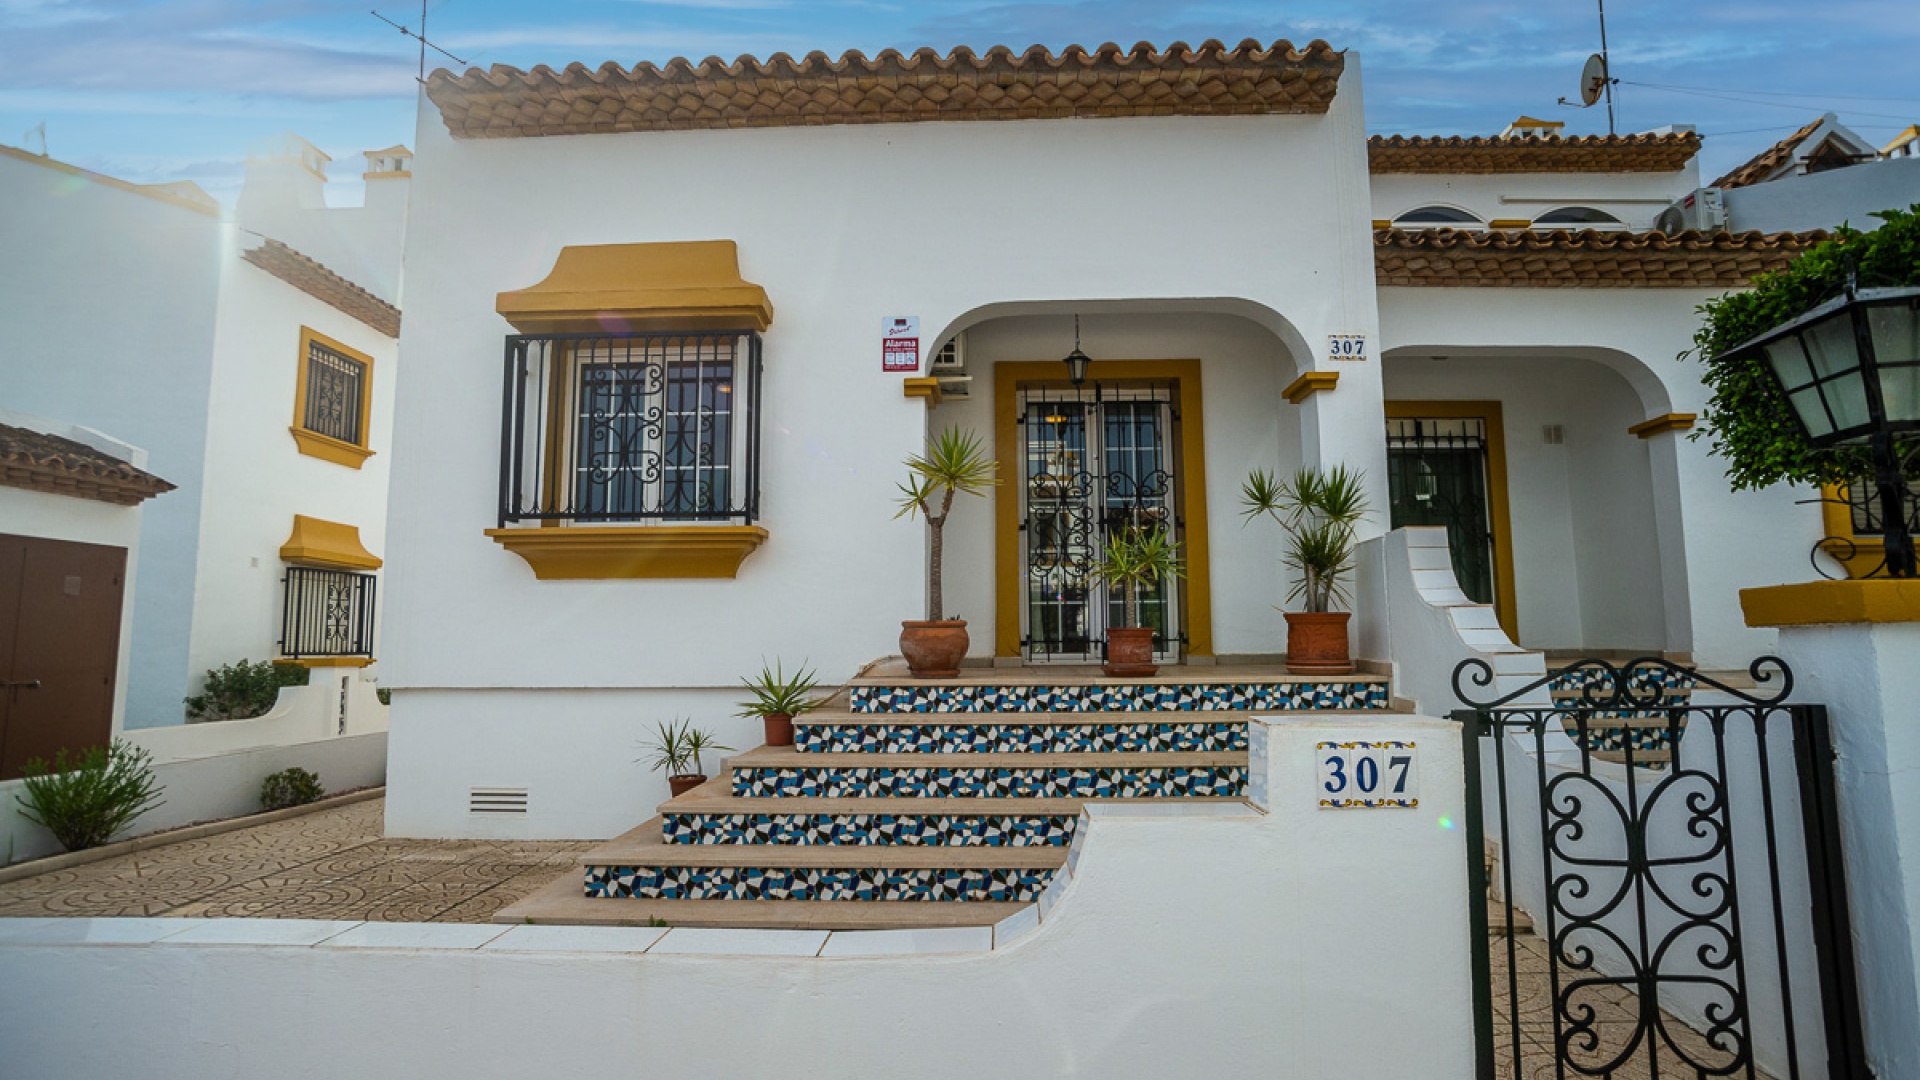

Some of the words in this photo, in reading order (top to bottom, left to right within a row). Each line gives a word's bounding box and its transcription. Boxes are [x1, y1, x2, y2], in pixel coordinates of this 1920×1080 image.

[885, 339, 916, 347] Alarma
[1330, 339, 1364, 355] 307
[1324, 755, 1412, 794] 307
